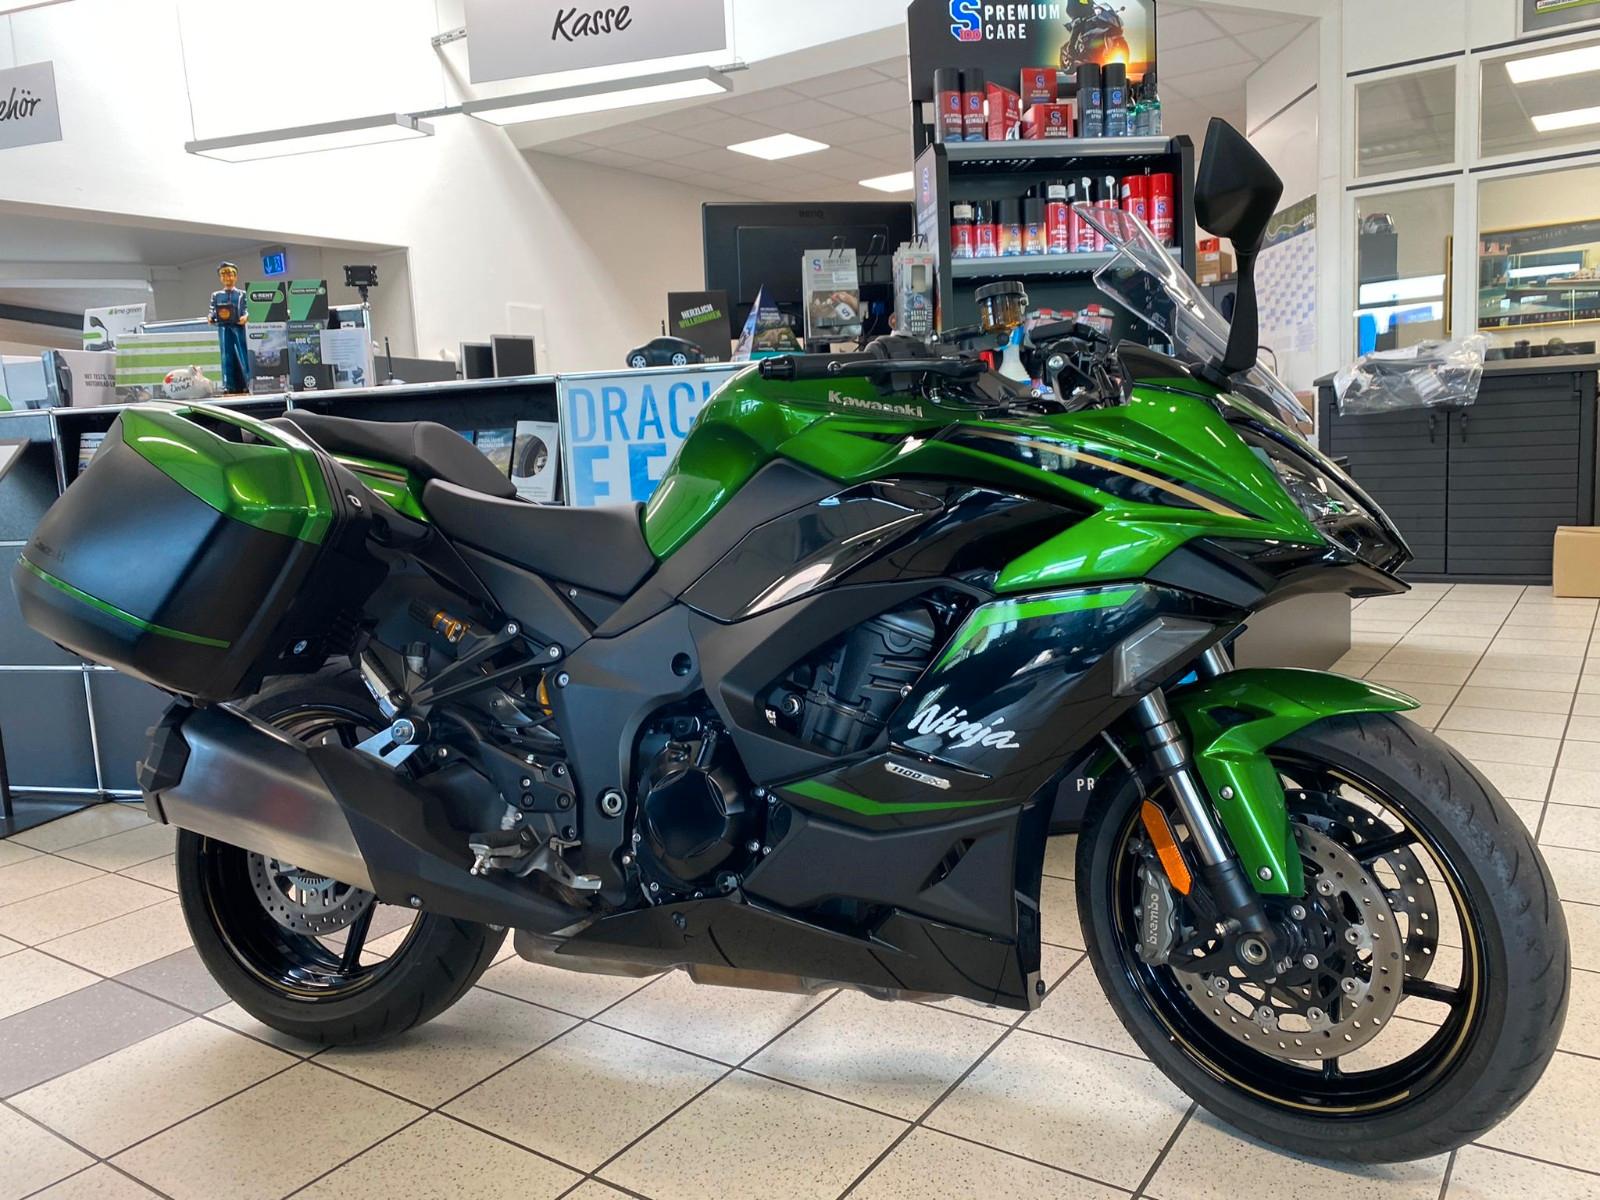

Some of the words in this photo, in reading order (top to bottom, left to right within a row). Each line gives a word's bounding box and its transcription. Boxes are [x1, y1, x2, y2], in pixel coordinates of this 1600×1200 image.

[551, 5, 633, 42] Kasse
[984, 4, 1060, 20] PREMIUM
[985, 23, 1027, 40] CARE
[680, 303, 714, 320] HERZLICH
[828, 389, 923, 418] Kawasaki
[907, 703, 1020, 750] Ninja
[1076, 778, 1096, 792] PR
[1147, 892, 1160, 946] brembo
